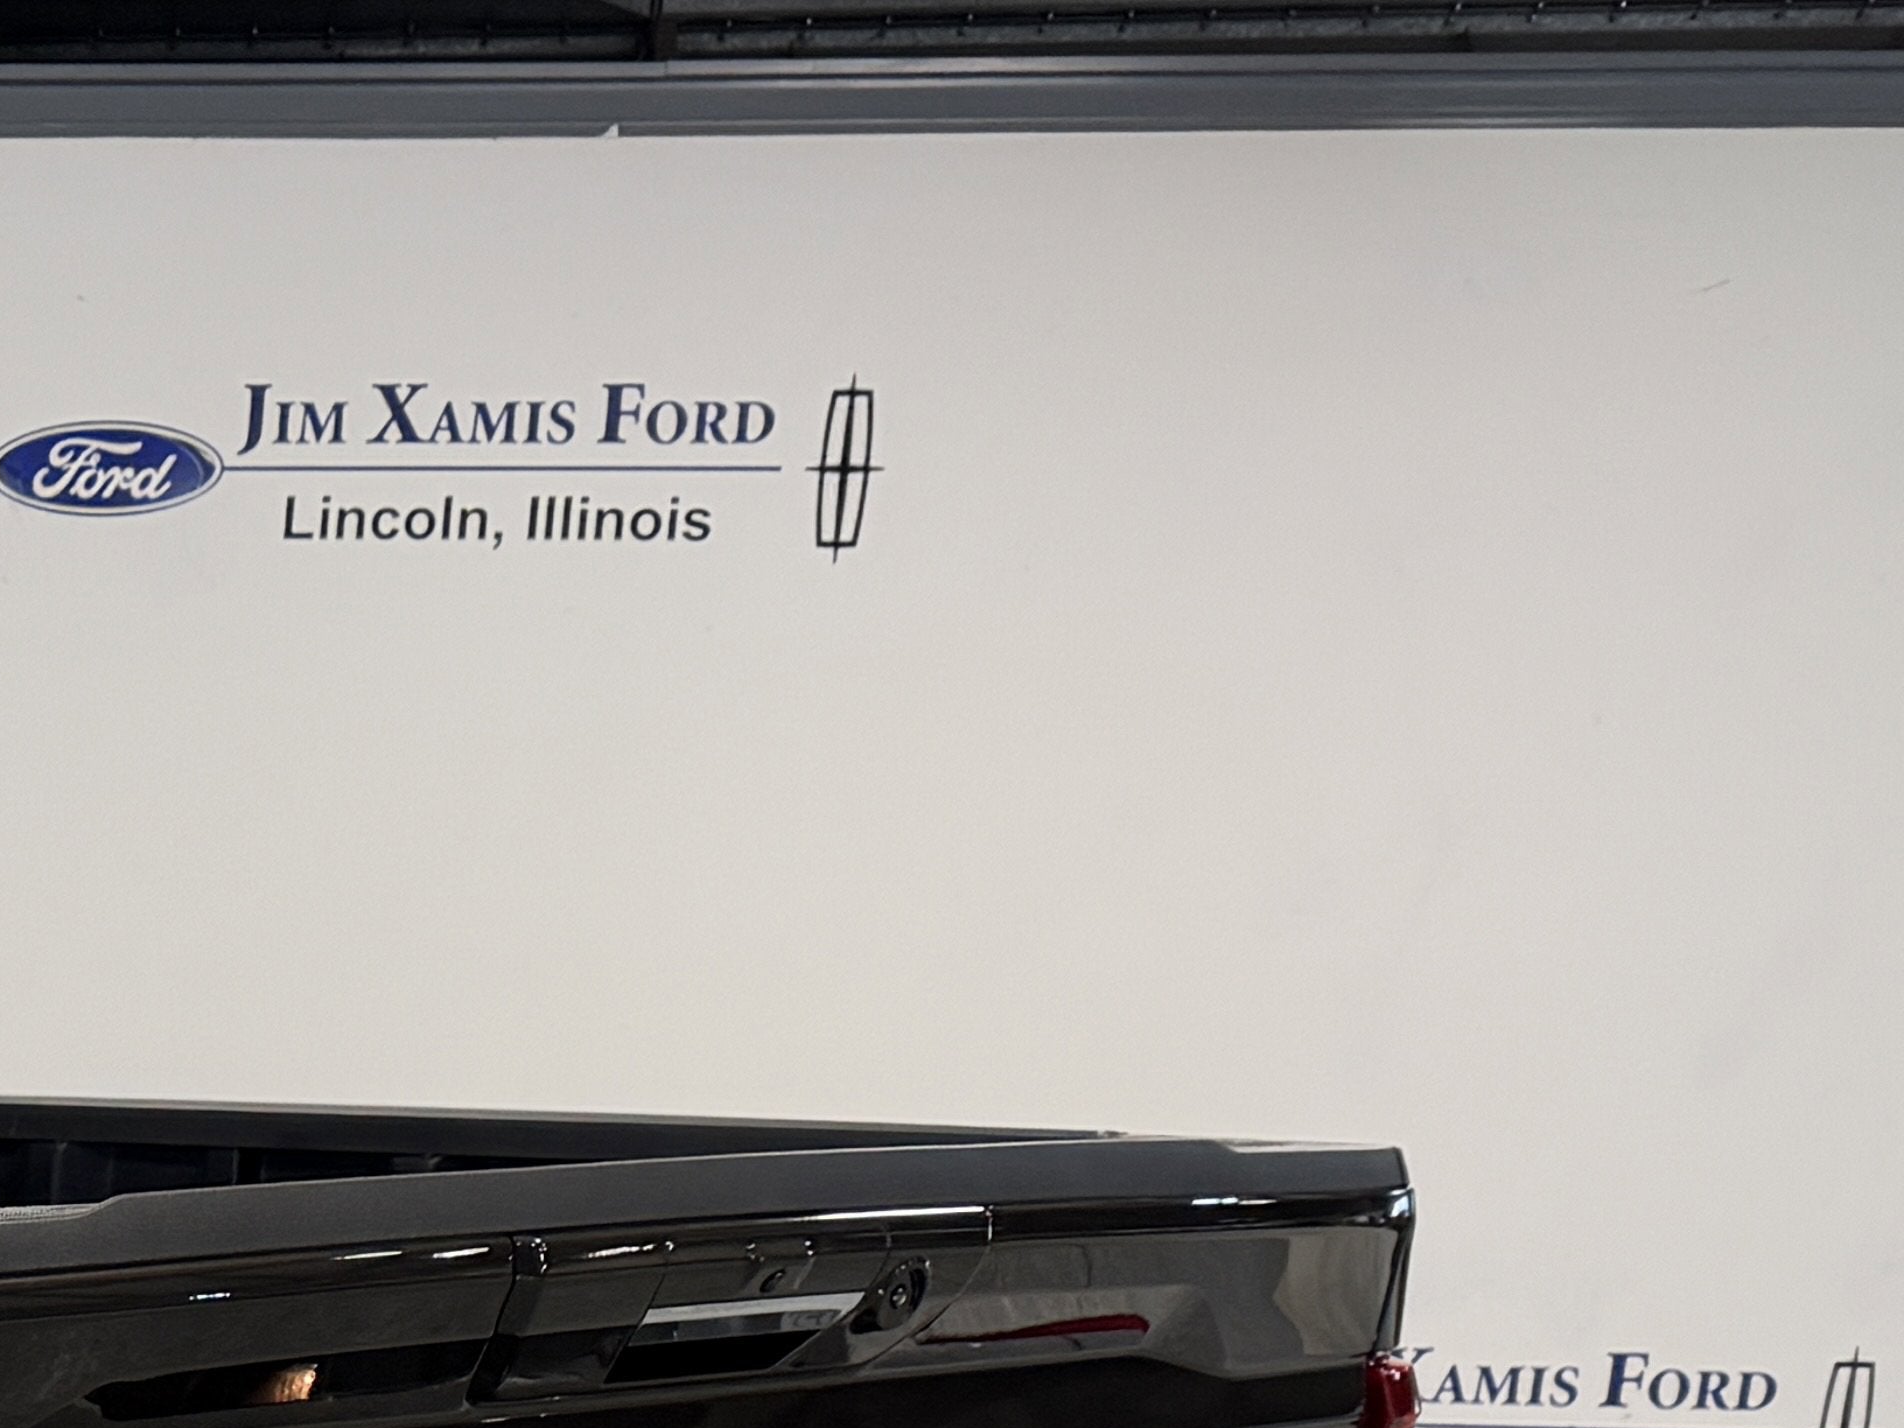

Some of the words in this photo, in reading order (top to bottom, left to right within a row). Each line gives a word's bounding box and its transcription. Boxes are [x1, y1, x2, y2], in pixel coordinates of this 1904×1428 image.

[30, 436, 175, 502] Ford
[282, 495, 504, 551] Lincoln,
[526, 495, 712, 542] Illinois
